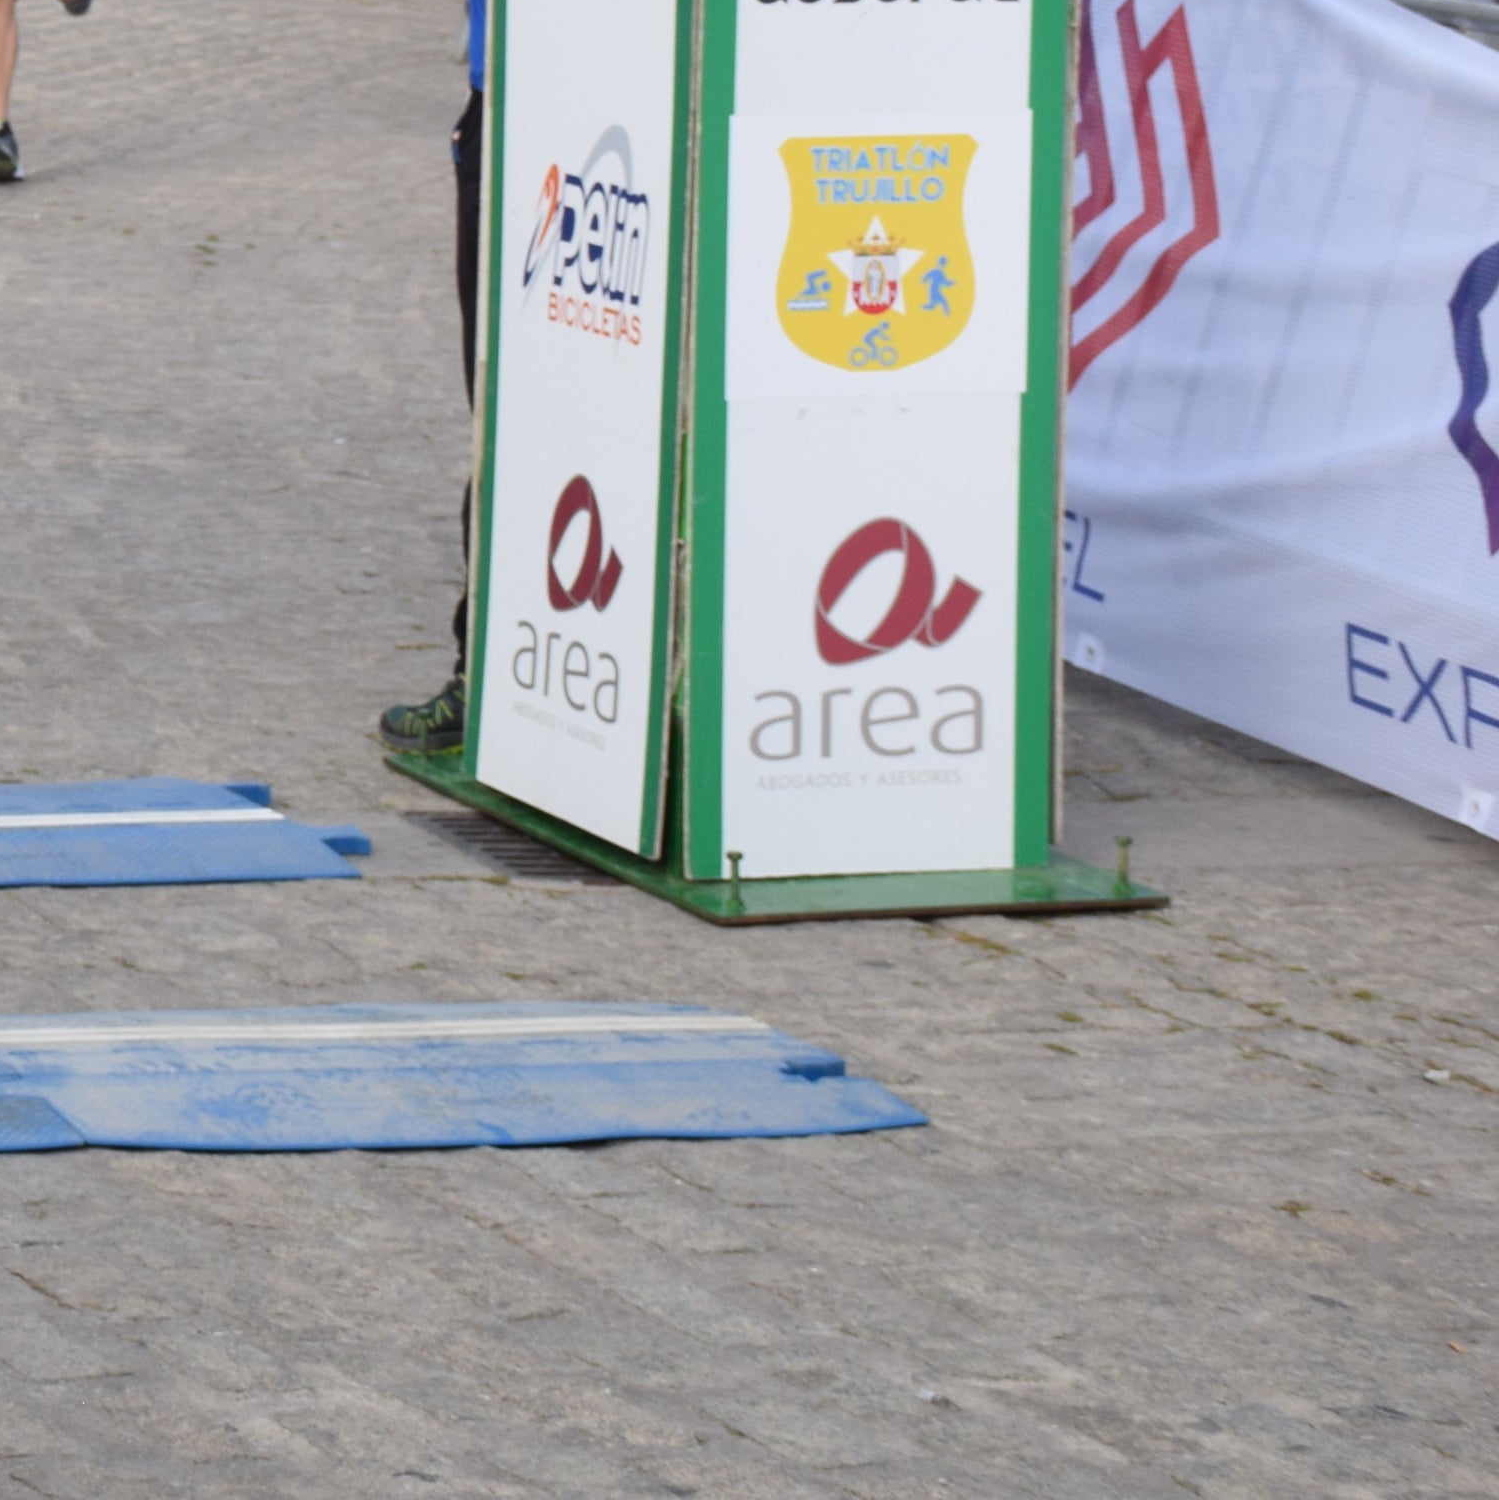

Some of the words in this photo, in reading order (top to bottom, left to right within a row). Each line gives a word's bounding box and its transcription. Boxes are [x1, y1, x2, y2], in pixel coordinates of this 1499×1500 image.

[811, 141, 950, 171] TRIATLÓN
[815, 176, 945, 204] TRUJILLO
[547, 292, 642, 346] BICICLETAS
[511, 619, 620, 724] area
[748, 683, 986, 762] area
[756, 772, 852, 790] ABOGADOS
[858, 772, 871, 786] Y
[877, 769, 963, 787] ASESORES
